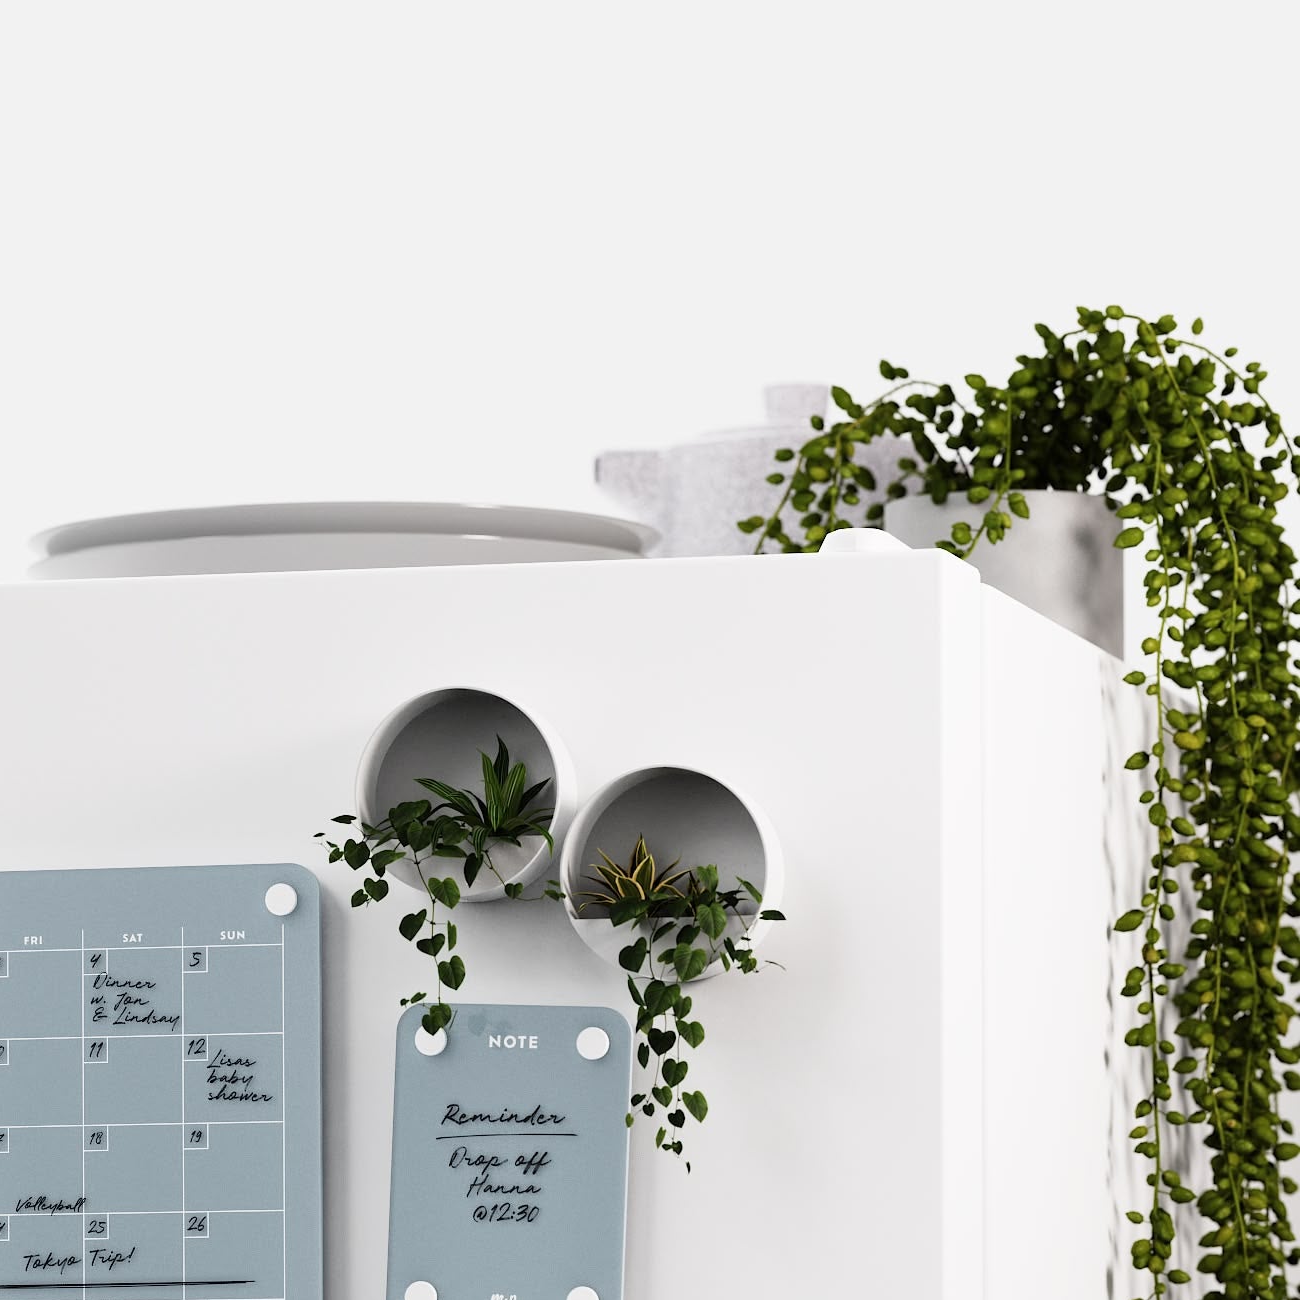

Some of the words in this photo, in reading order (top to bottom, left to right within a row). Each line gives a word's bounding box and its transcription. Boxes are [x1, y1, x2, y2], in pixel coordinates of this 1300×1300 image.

[24, 936, 42, 945] FRI
[122, 933, 142, 943] SAT
[220, 931, 245, 940] SUN
[90, 954, 100, 968] 4
[189, 952, 200, 967] 5
[93, 972, 156, 989] Dinner
[114, 993, 149, 1011] Jon
[93, 1007, 107, 1022] &
[113, 1008, 180, 1031] Lindsay
[89, 1042, 102, 1058] 11
[188, 1038, 205, 1055] 12
[488, 1036, 538, 1049] NOTE
[207, 1049, 257, 1069] Lisas
[207, 1070, 254, 1088] baby
[207, 1086, 273, 1102] shower
[441, 1104, 566, 1126] Reminder
[89, 1130, 102, 1145] 18
[189, 1130, 202, 1143] 19
[449, 1147, 508, 1175] Drop
[515, 1152, 552, 1175] off
[467, 1174, 542, 1198] Hanna
[16, 1197, 86, 1216] Volleyball
[472, 1203, 540, 1223] @12:30
[88, 1219, 106, 1234] 25
[187, 1217, 205, 1231] 26
[24, 1252, 83, 1274] Tokyo
[89, 1247, 136, 1271] Trip!
